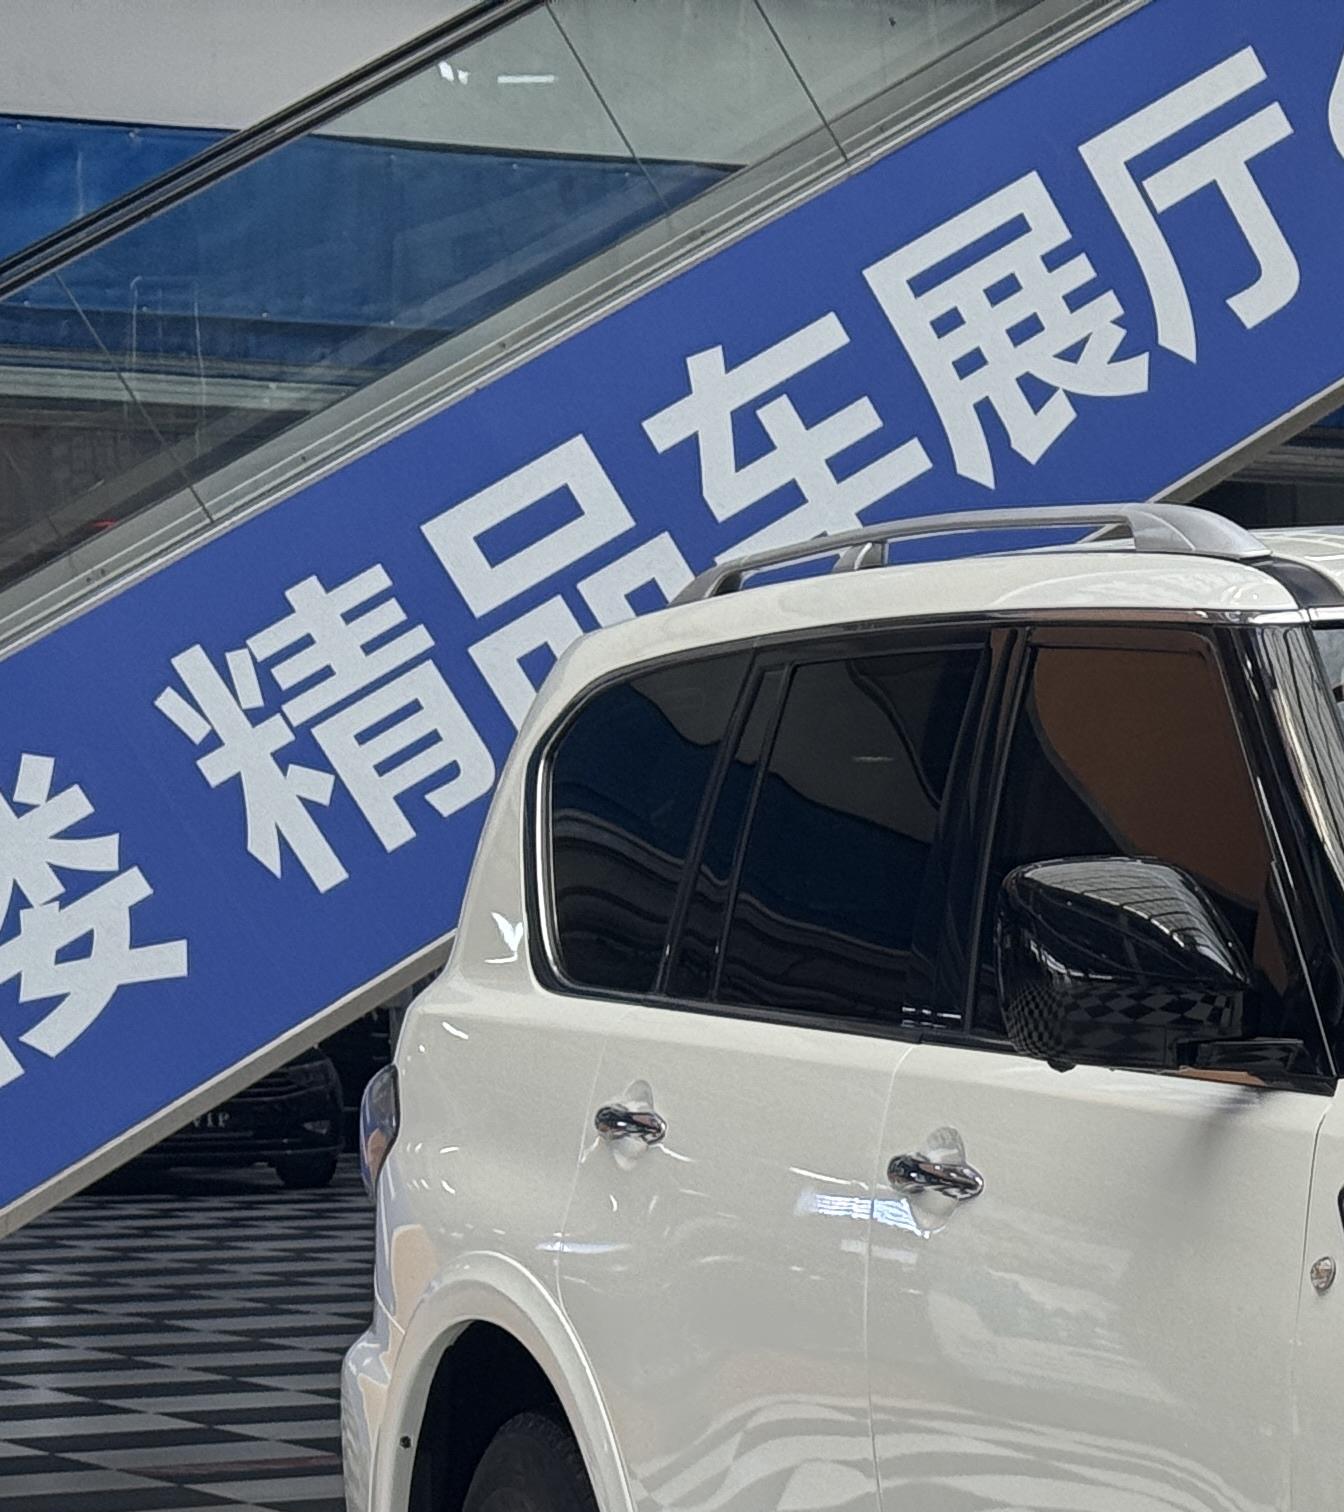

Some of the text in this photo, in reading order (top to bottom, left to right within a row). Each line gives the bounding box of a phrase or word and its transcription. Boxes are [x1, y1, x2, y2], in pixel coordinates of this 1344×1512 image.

[155, 45, 1303, 894] 精品车展厅
